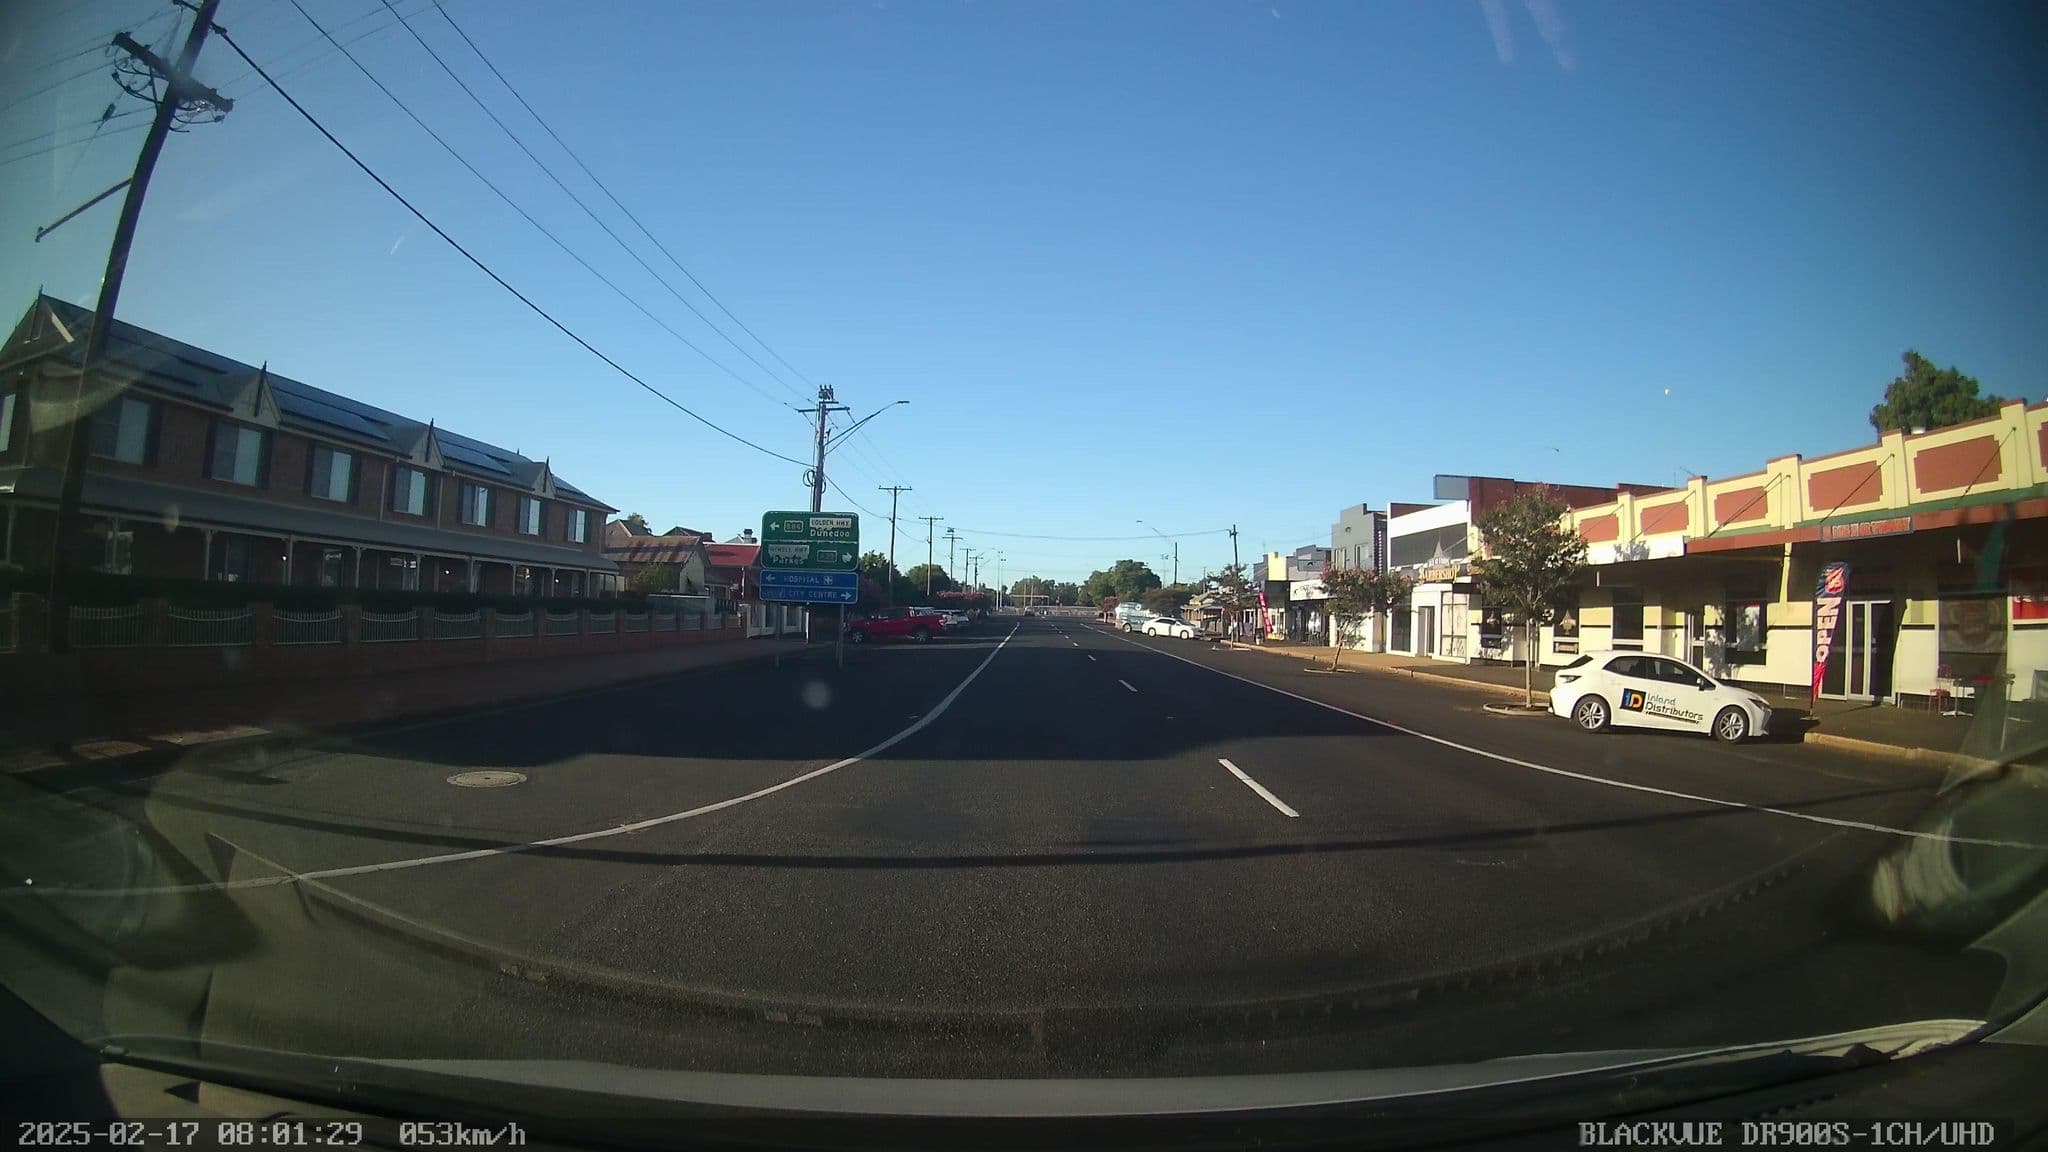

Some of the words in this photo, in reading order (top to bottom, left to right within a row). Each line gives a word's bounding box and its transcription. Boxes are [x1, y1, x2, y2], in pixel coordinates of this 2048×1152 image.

[810, 528, 850, 537] Dunedoo
[772, 555, 804, 565] Parkes
[783, 575, 820, 585] HOSPITAL
[808, 591, 837, 599] CENTRE
[1816, 597, 1842, 663] OPEN
[1647, 693, 1676, 706] Inland
[1645, 701, 1704, 721] Distributors
